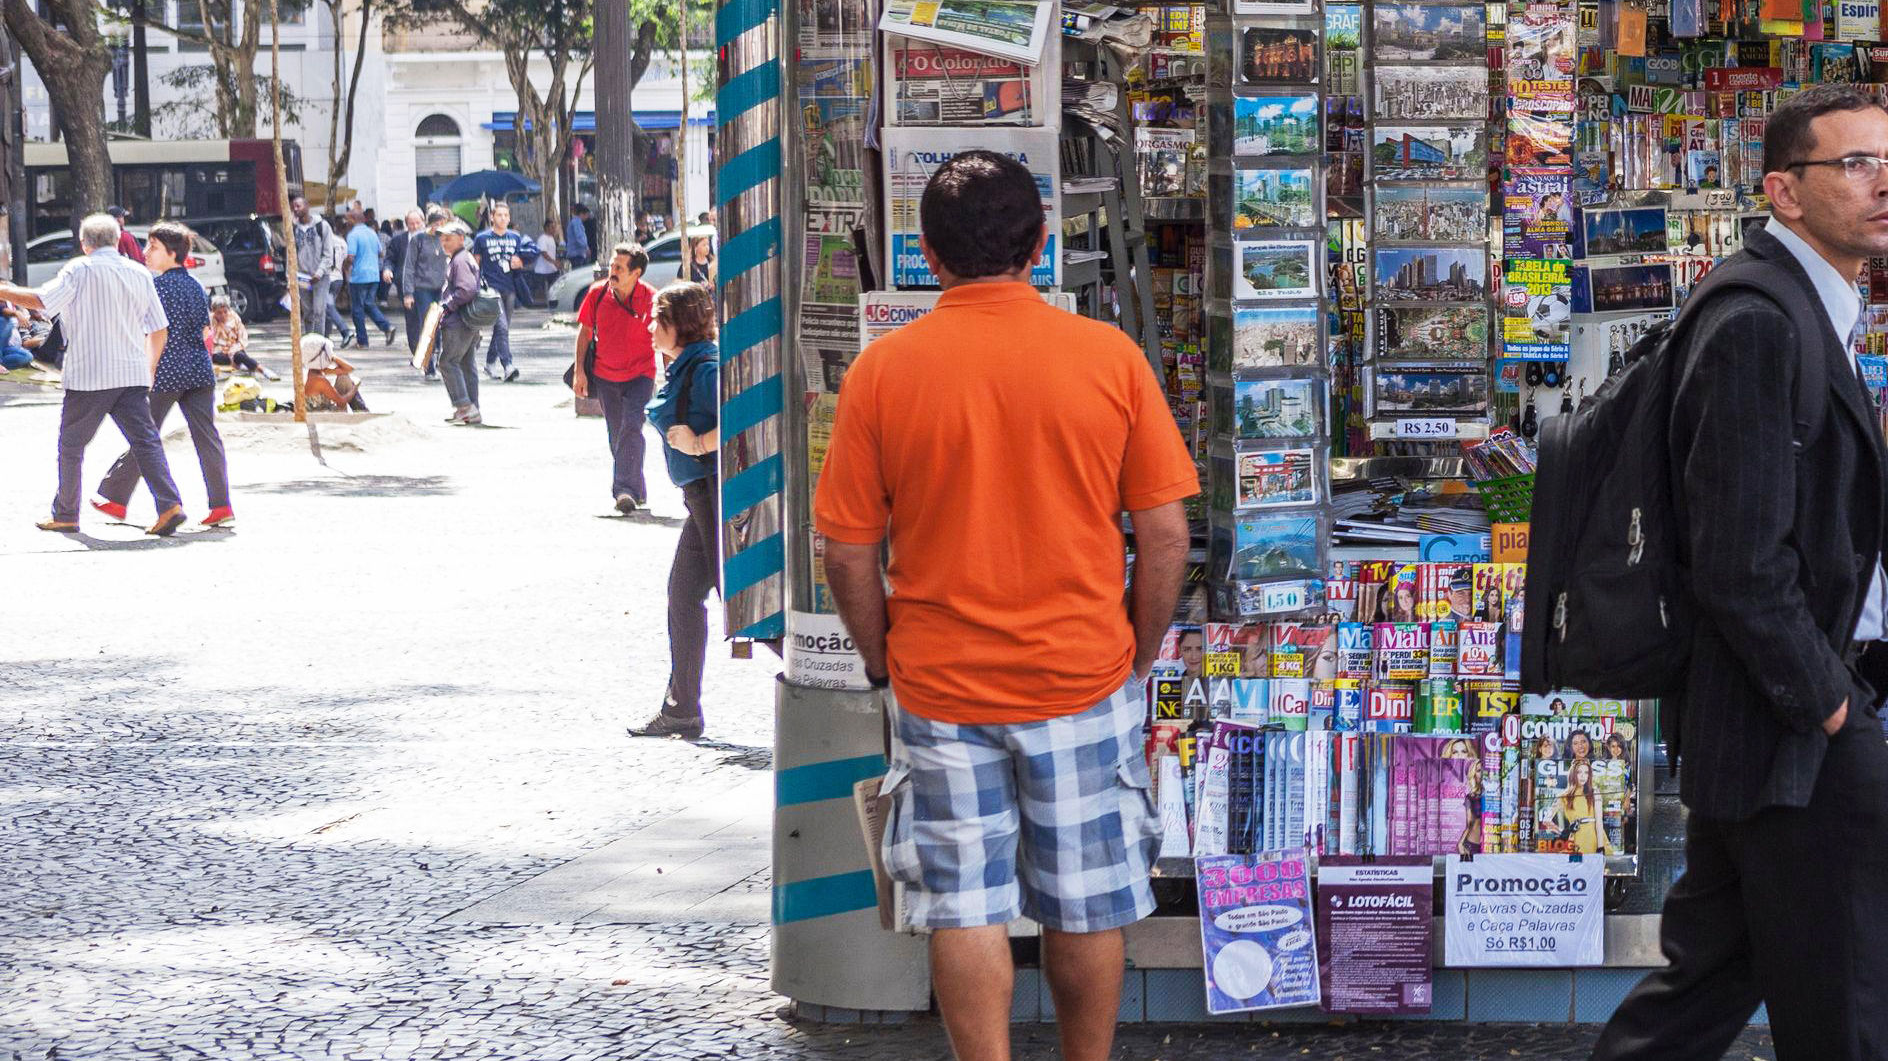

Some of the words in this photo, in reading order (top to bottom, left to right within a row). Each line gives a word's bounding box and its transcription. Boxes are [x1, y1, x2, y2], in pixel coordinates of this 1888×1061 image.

[914, 56, 928, 70] O
[1511, 80, 1530, 94] 10
[1532, 80, 1571, 89] TESTES
[1552, 262, 1565, 272] do
[1527, 284, 1551, 295] 2013
[1404, 423, 1420, 435] R$
[1424, 422, 1449, 435] 2,50
[1267, 593, 1297, 608] 1,50
[804, 658, 854, 671] Cruzadas
[1522, 718, 1614, 743] contigo!
[1538, 760, 1623, 776] GLSS
[1204, 860, 1304, 887] 3000
[1355, 868, 1399, 876] ESTATÍSTICAS
[1457, 874, 1587, 895] Promoção
[1204, 881, 1305, 907] EMPRESAS
[1348, 893, 1414, 907] LOTOFÁCIL
[1459, 902, 1516, 914] Palavras
[1521, 902, 1583, 914] Cruzadas
[1467, 923, 1475, 931] e
[1480, 919, 1513, 934] Caça
[1518, 919, 1576, 931] Palavras
[1486, 936, 1504, 949] Só
[1509, 936, 1556, 951] R$1,00
